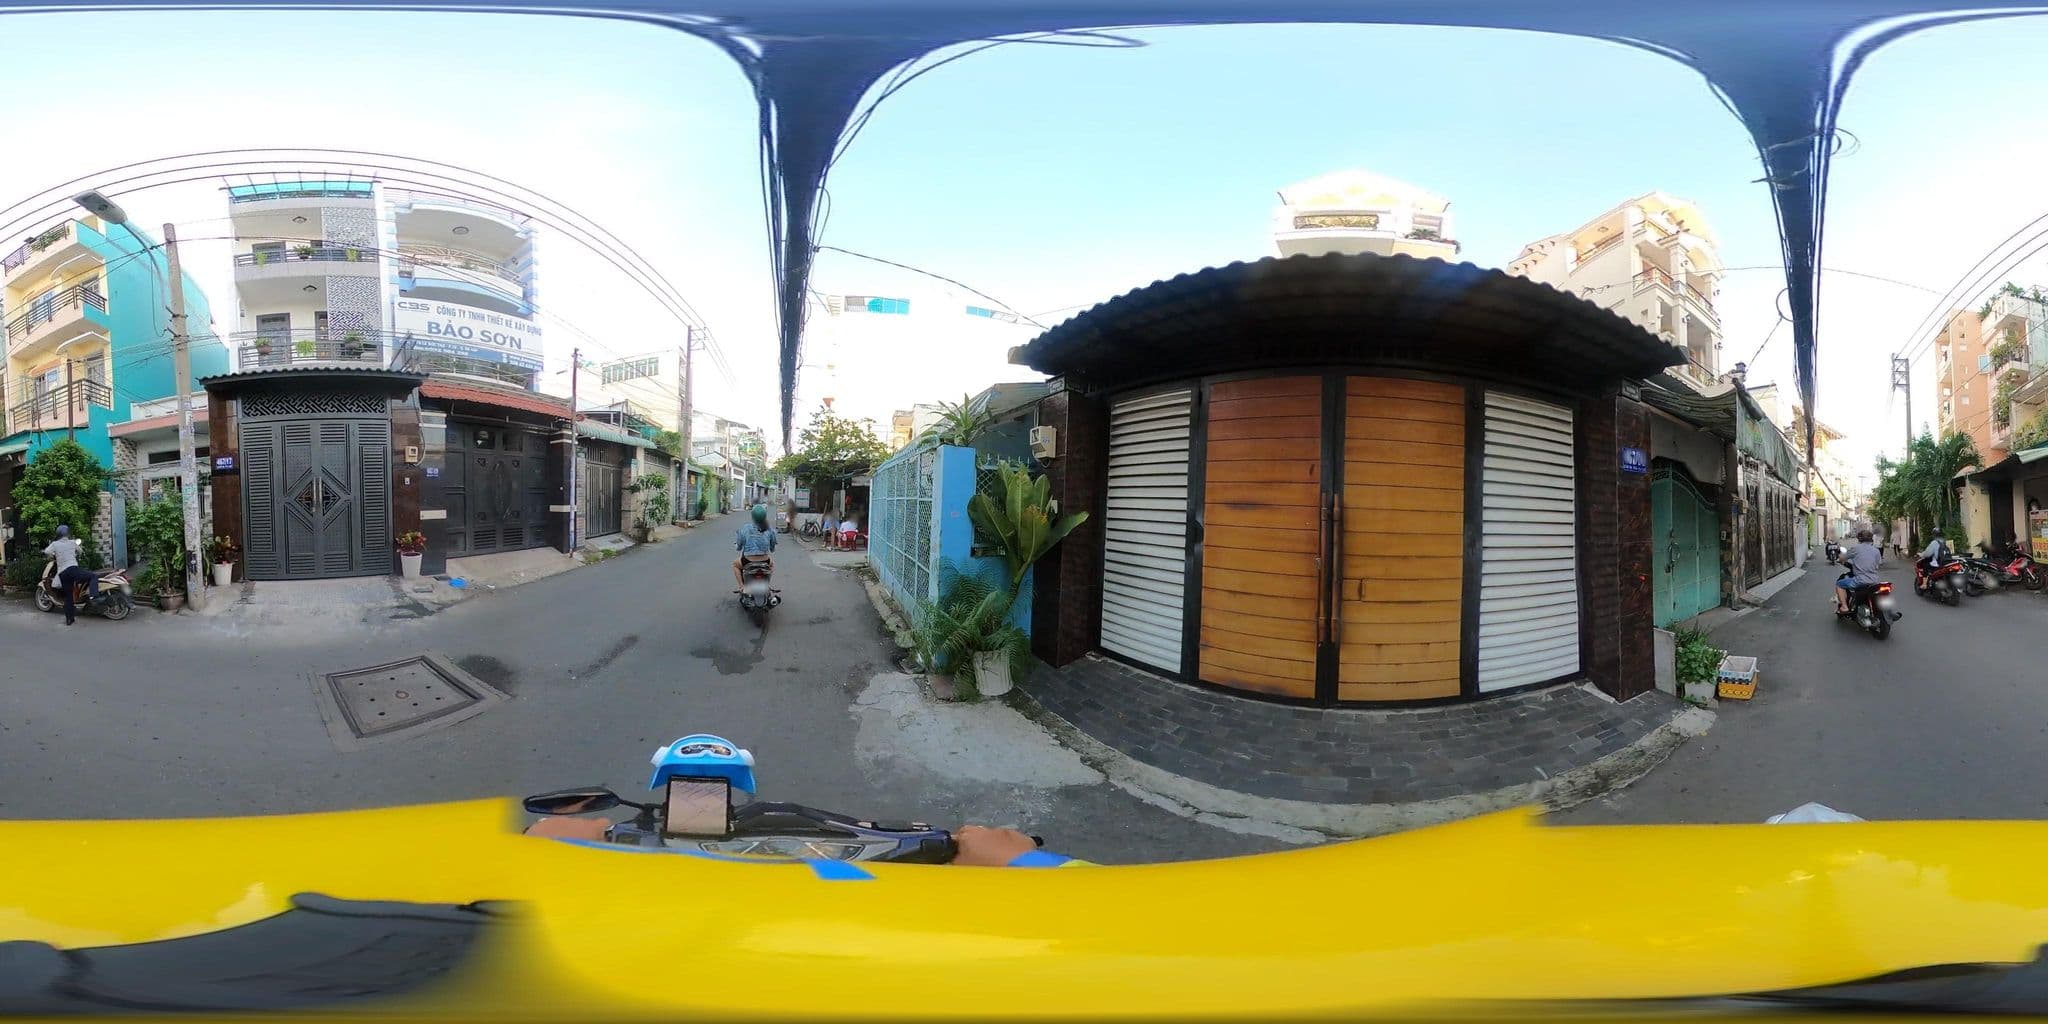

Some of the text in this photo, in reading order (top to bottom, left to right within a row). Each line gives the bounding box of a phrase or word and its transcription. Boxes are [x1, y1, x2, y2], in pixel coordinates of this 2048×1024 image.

[436, 304, 457, 317] CÔNG
[458, 308, 467, 319] TY
[468, 310, 486, 322] TNHH
[427, 320, 474, 340] BẢO
[480, 329, 522, 350] SƠN
